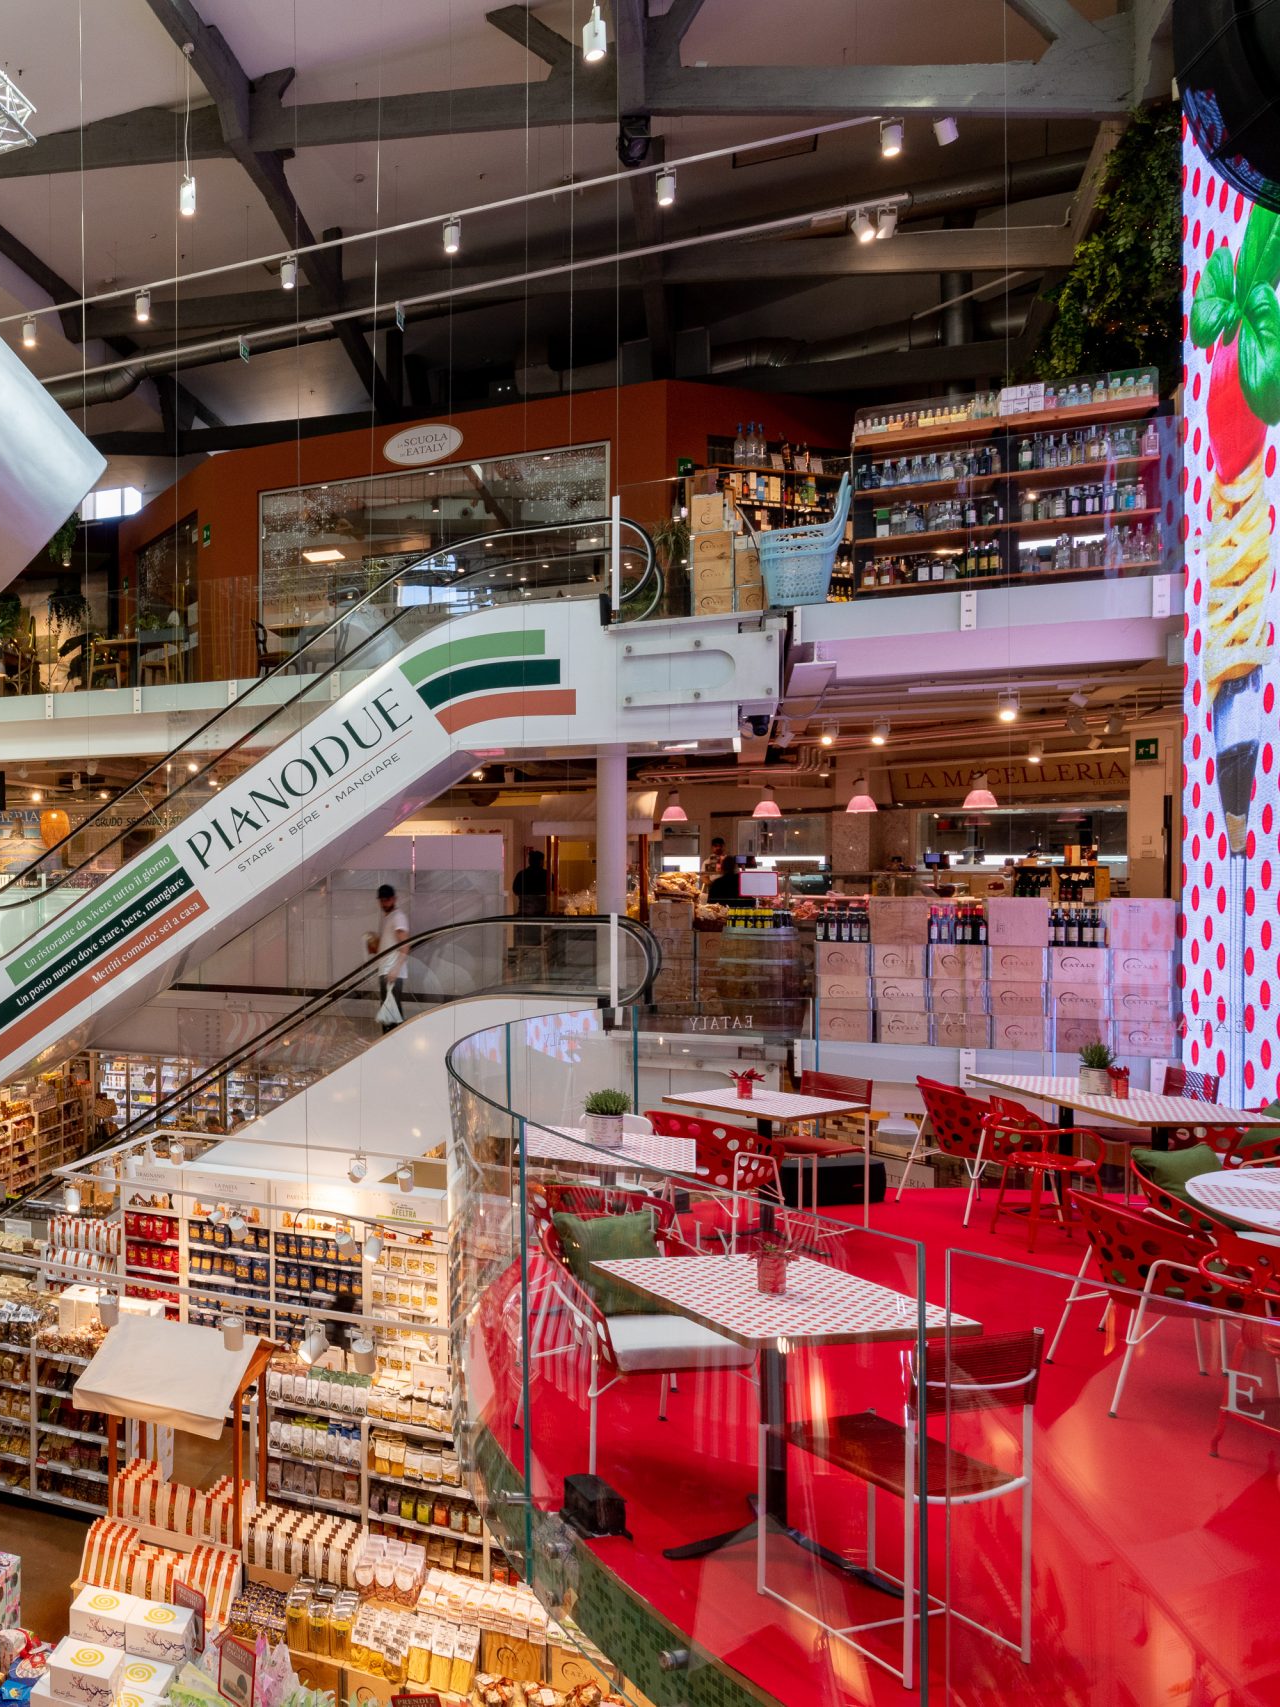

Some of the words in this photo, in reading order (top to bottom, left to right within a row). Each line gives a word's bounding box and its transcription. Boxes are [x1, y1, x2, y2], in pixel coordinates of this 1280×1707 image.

[404, 433, 448, 447] SCUOLA
[406, 443, 446, 457] EATALY
[186, 688, 413, 870] PIANODUE
[237, 842, 275, 873] STARE
[288, 810, 321, 836] BERE
[335, 752, 401, 803] MANGIARE
[905, 770, 936, 789] LA
[16, 992, 29, 1007] Un
[27, 977, 53, 1006] posto
[52, 959, 78, 981] nuovo
[77, 941, 100, 964] dove
[98, 925, 125, 948] stare,
[121, 908, 147, 930] bere,
[144, 876, 186, 912] mangiare
[23, 957, 37, 970] Un
[36, 928, 75, 962] ristorante
[75, 919, 87, 937] da
[85, 899, 113, 927] vivere
[112, 882, 136, 907] tutto
[134, 876, 143, 891] il
[141, 855, 171, 883] giorno
[91, 957, 122, 984] Mettiti
[121, 931, 160, 966] comodo:
[158, 919, 172, 936] sei
[178, 900, 201, 921] casa
[391, 1207, 417, 1219] AFELTRA
[1220, 1368, 1265, 1420] E
